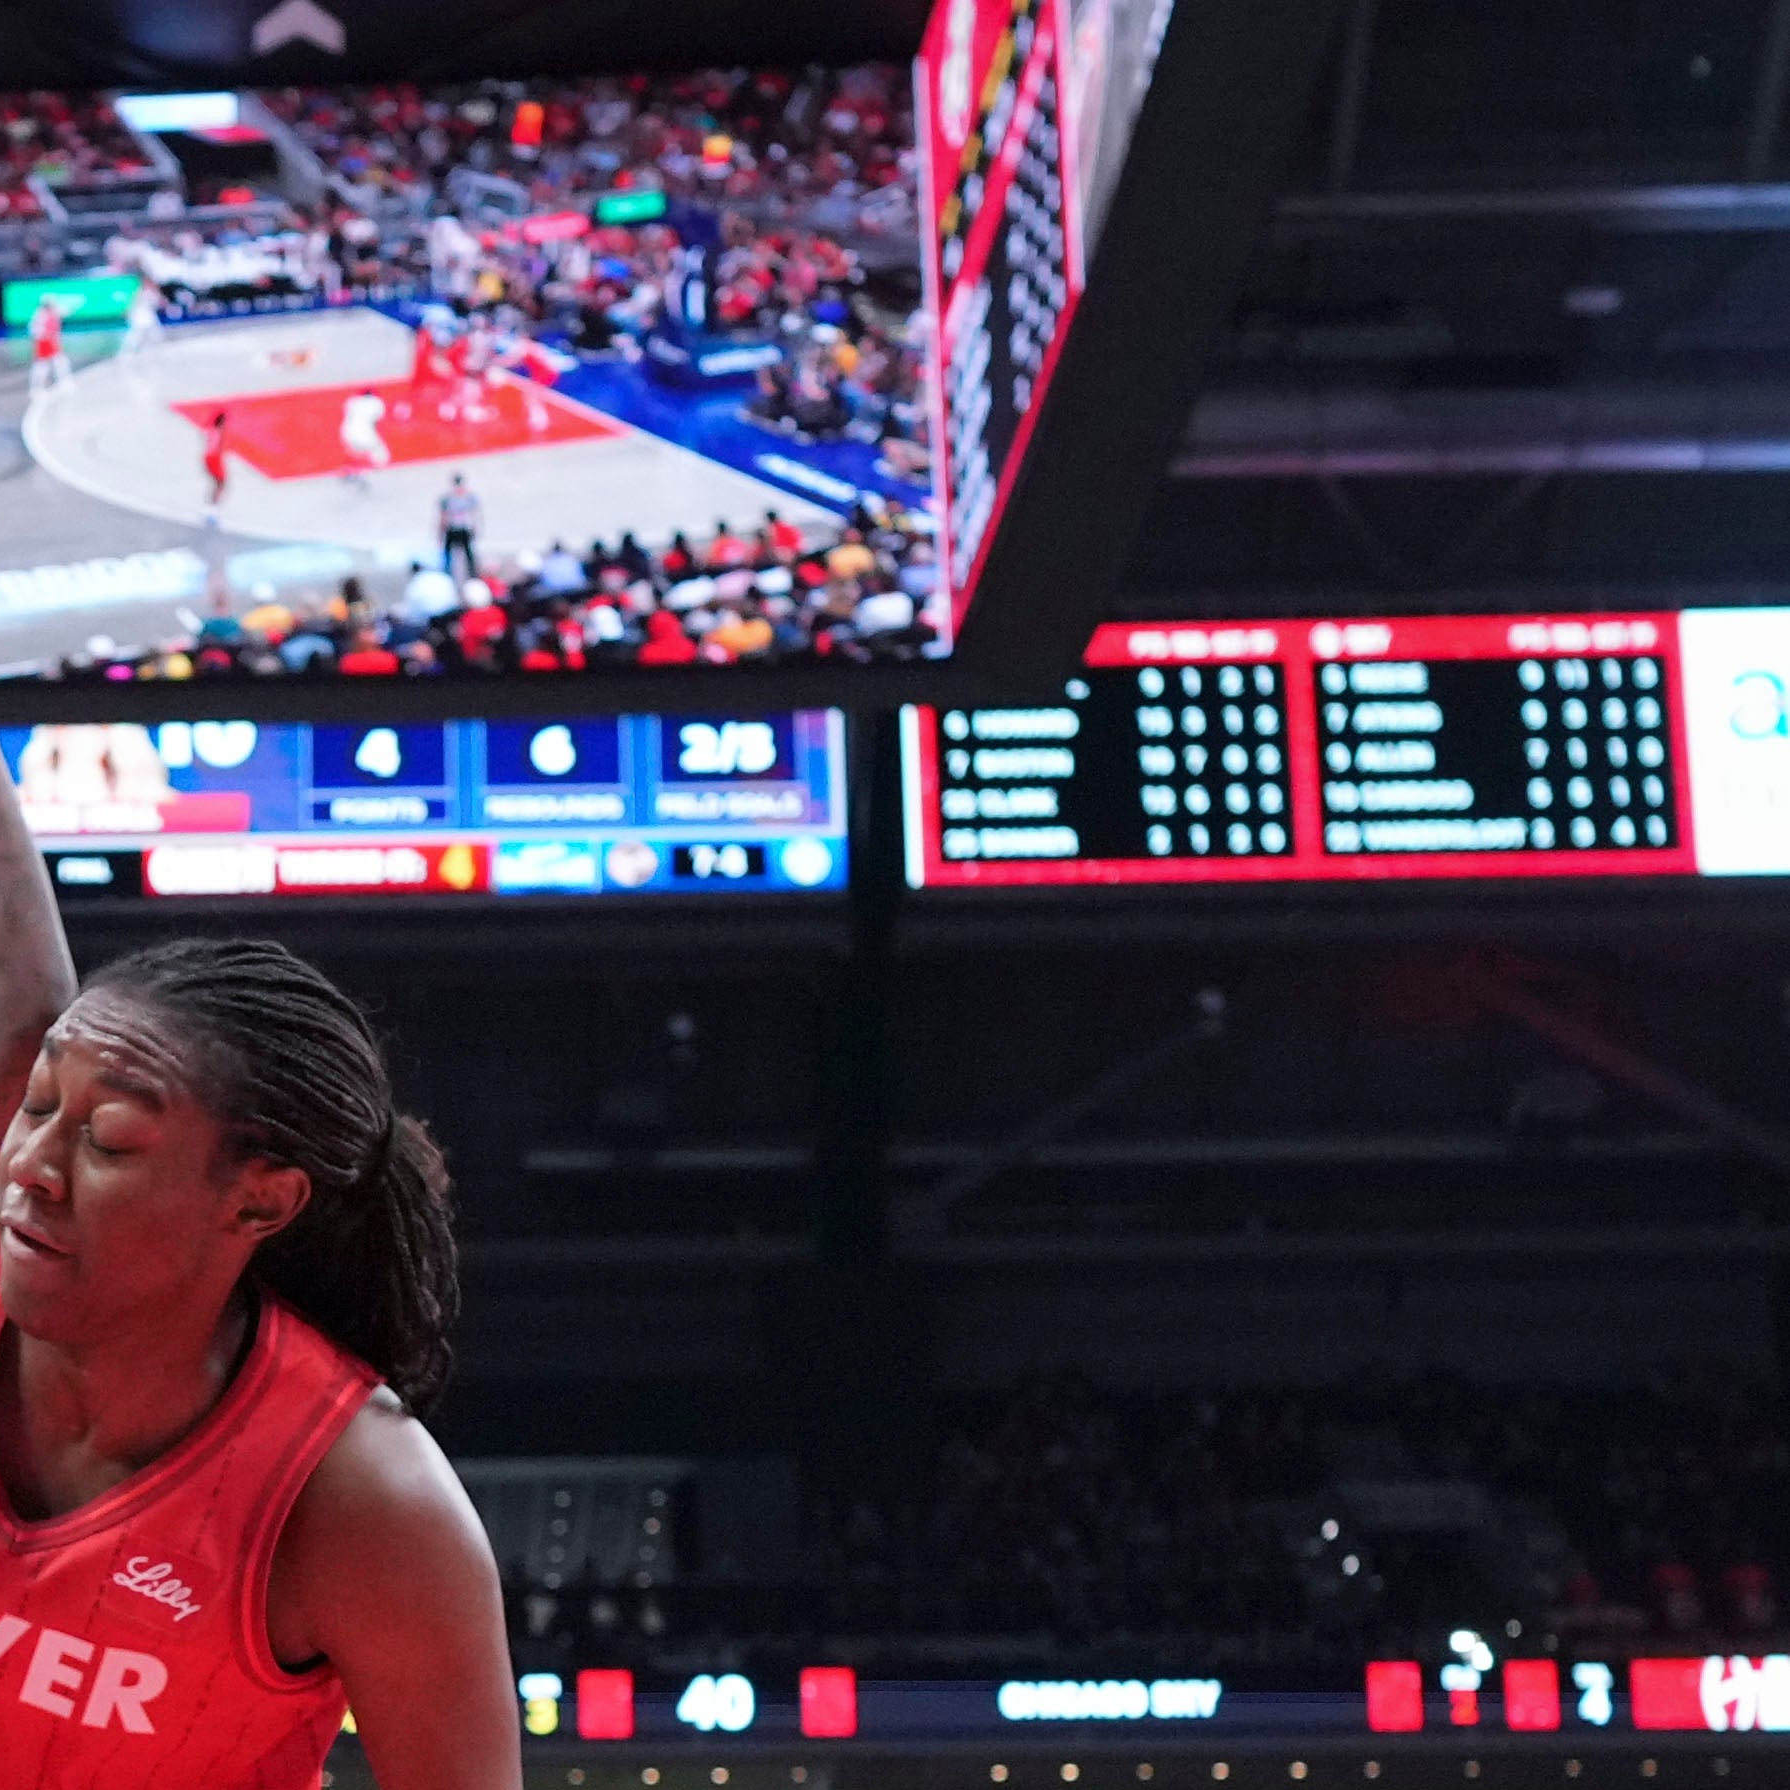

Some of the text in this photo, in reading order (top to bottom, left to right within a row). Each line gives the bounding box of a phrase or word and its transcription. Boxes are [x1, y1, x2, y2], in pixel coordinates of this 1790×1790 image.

[357, 729, 401, 777] 4
[531, 726, 576, 775] 6
[112, 1555, 203, 1623] Lilly
[676, 1673, 756, 1732] 40
